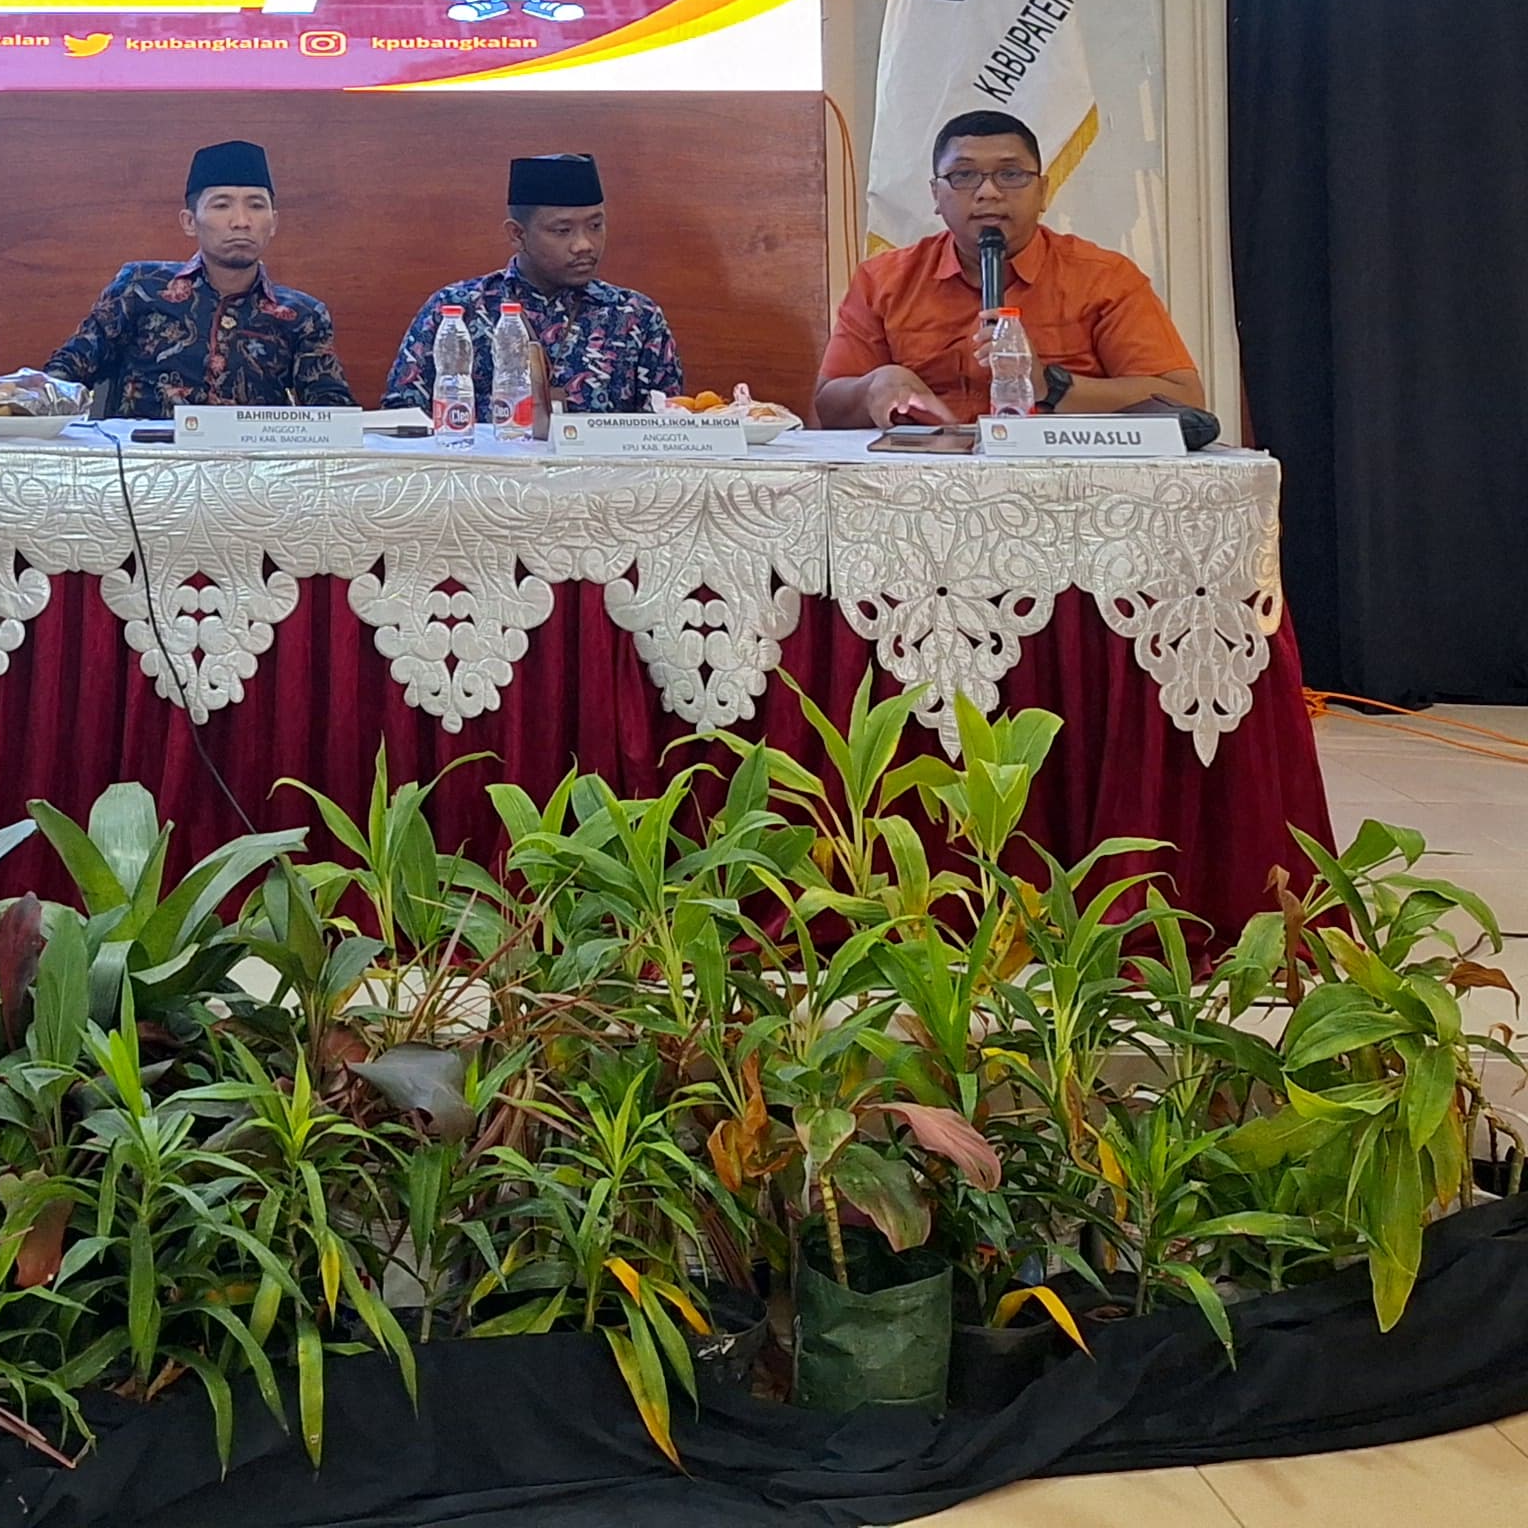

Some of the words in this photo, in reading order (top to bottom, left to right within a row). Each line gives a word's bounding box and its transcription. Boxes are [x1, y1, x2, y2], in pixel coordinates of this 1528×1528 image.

[126, 35, 289, 51] kpubangkalan
[372, 35, 538, 51] kpubangkalan
[237, 411, 314, 421] BAHIRUDDIN,
[451, 410, 469, 422] Cleo
[642, 433, 689, 442] ANGGOTA
[1043, 430, 1142, 446] BAWASLU
